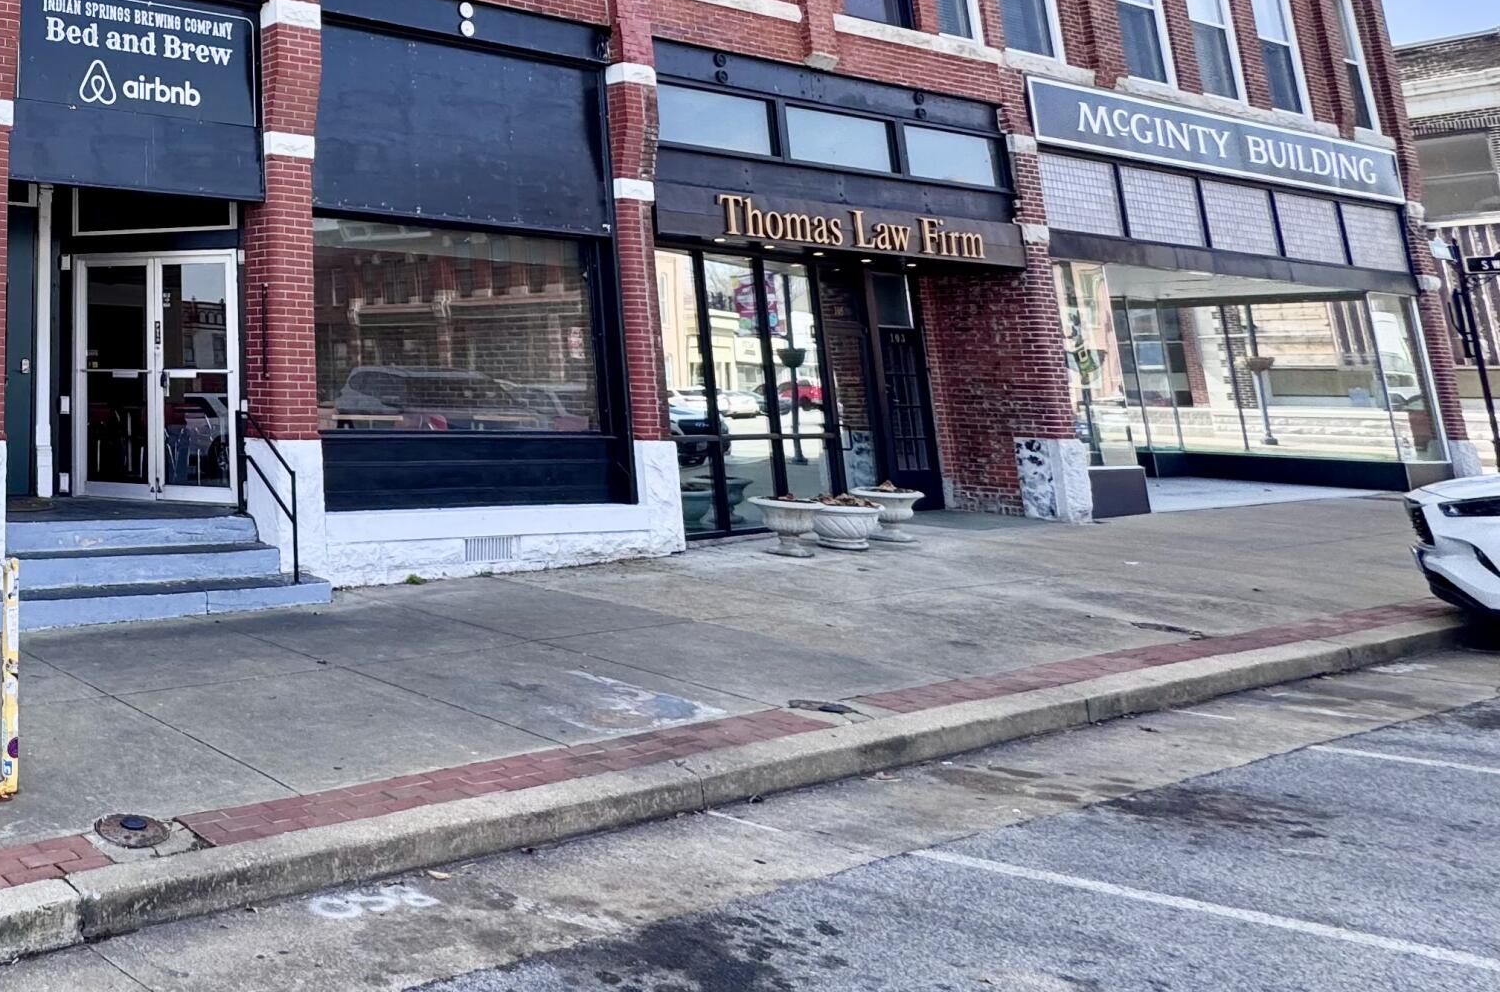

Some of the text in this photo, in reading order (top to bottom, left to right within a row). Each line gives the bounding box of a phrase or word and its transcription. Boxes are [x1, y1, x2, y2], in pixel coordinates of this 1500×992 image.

[45, 16, 233, 65] Bed and Brew
[85, 1, 131, 23] SPRINGS
[134, 11, 181, 32] BREWING
[184, 18, 233, 40] COMPANY
[123, 75, 201, 106] airbnb
[1246, 135, 1378, 185] BUILDING
[715, 194, 986, 259] Thomas Law Firm
[1480, 260, 1490, 270] S
